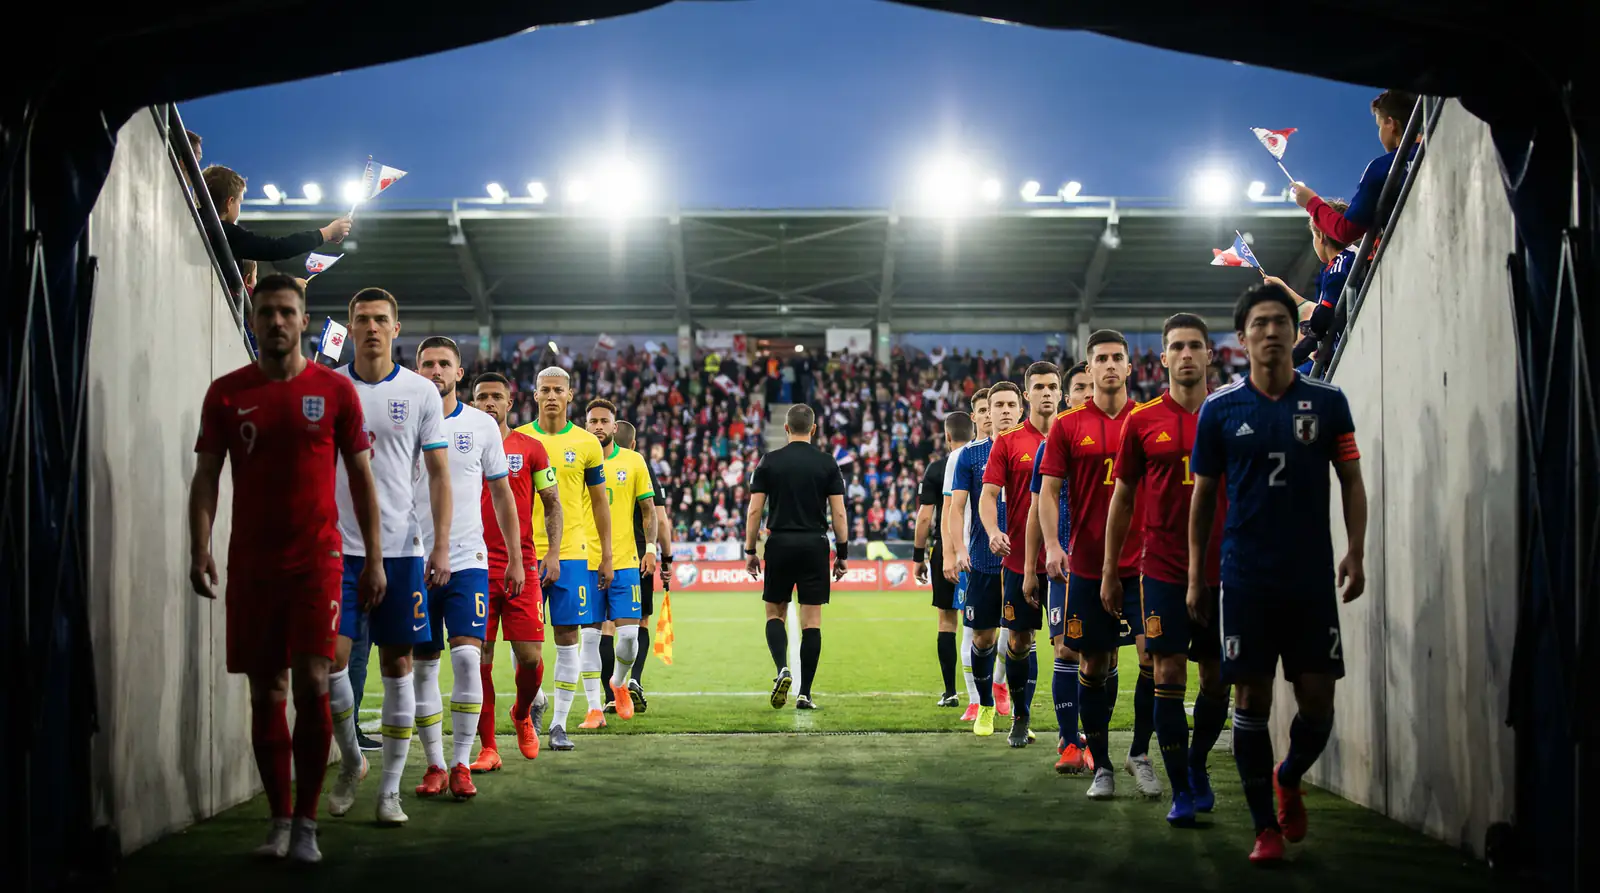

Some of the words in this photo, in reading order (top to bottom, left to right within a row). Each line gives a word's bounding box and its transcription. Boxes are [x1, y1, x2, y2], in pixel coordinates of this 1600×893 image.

[239, 420, 257, 455] 9
[545, 469, 554, 482] C
[1181, 455, 1195, 486] 1
[1267, 451, 1288, 487] 2
[701, 568, 765, 584] EUROP
[412, 591, 426, 619] 2
[474, 592, 486, 618] 6
[578, 585, 588, 607] 9
[1328, 626, 1341, 660] 2
